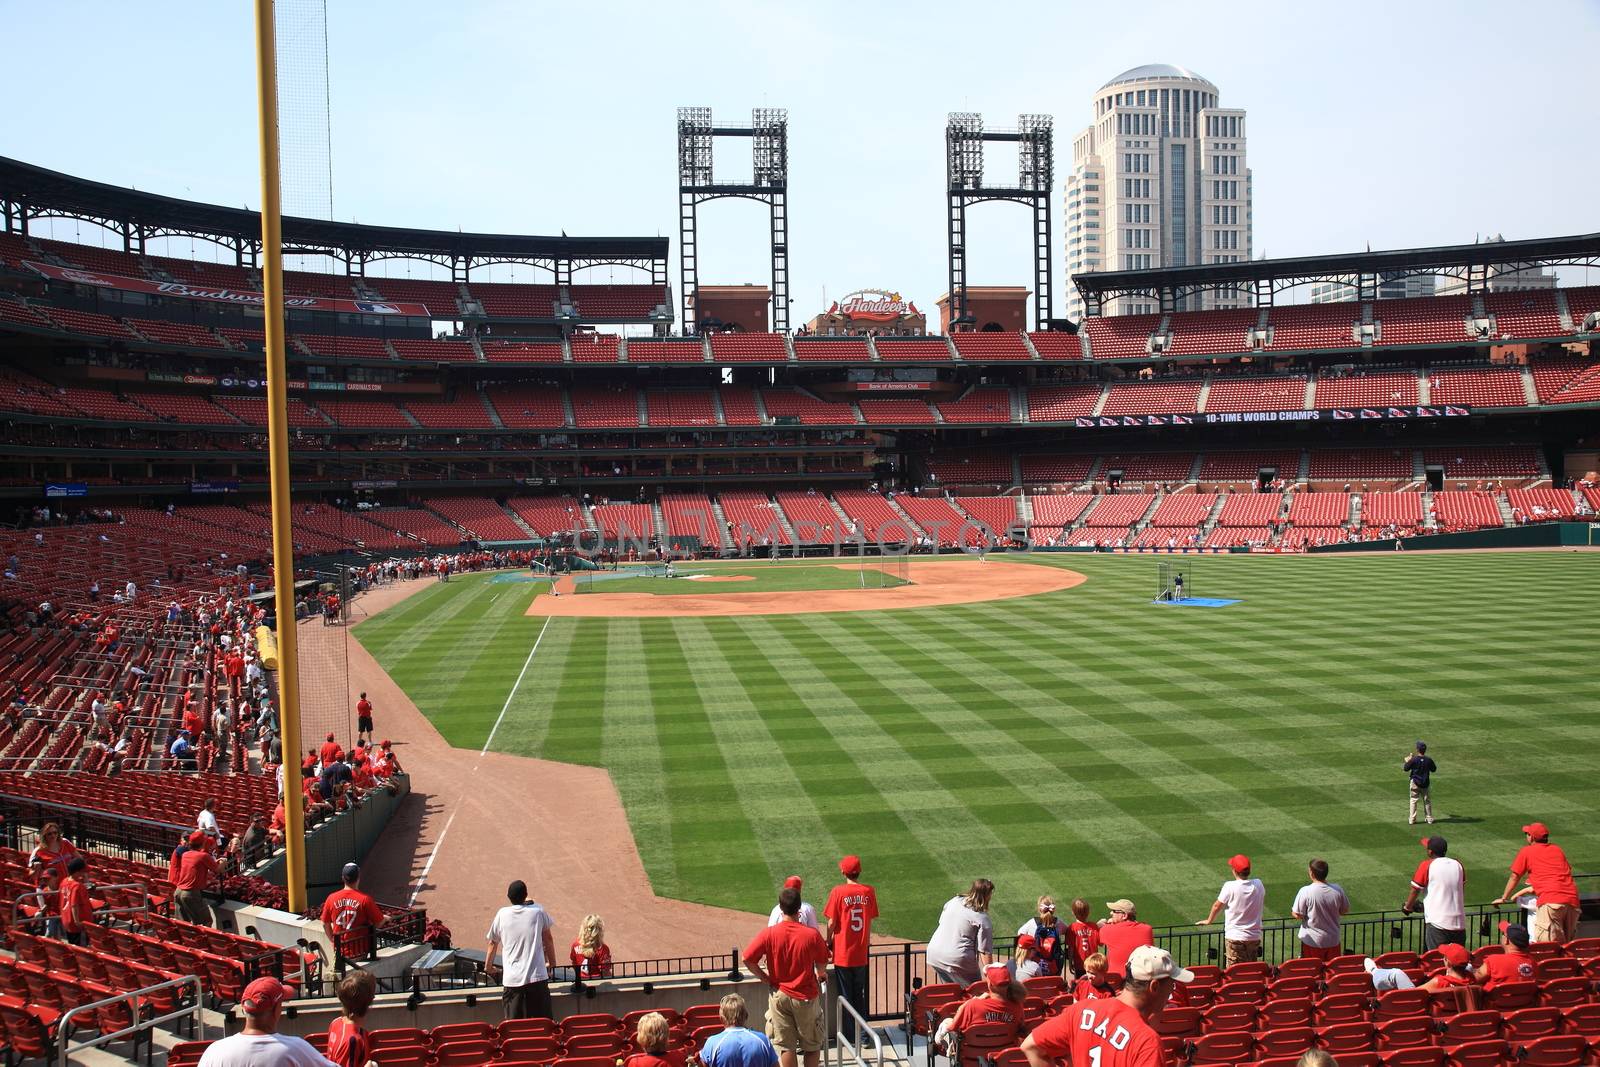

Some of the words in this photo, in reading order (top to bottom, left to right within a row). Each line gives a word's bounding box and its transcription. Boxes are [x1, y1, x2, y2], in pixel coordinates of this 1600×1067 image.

[157, 282, 317, 305] Budweer
[347, 383, 382, 391] CARDINALS.COM
[1206, 413, 1241, 423] 10-TIME
[1243, 412, 1277, 422] WORLD
[1279, 410, 1320, 421] CHAMPS
[843, 895, 869, 906] PUJOLS
[335, 909, 357, 930] 47
[850, 908, 863, 932] 5
[1082, 937, 1089, 951] 5
[1080, 1008, 1130, 1050] DAD
[1088, 1045, 1102, 1067] 1
